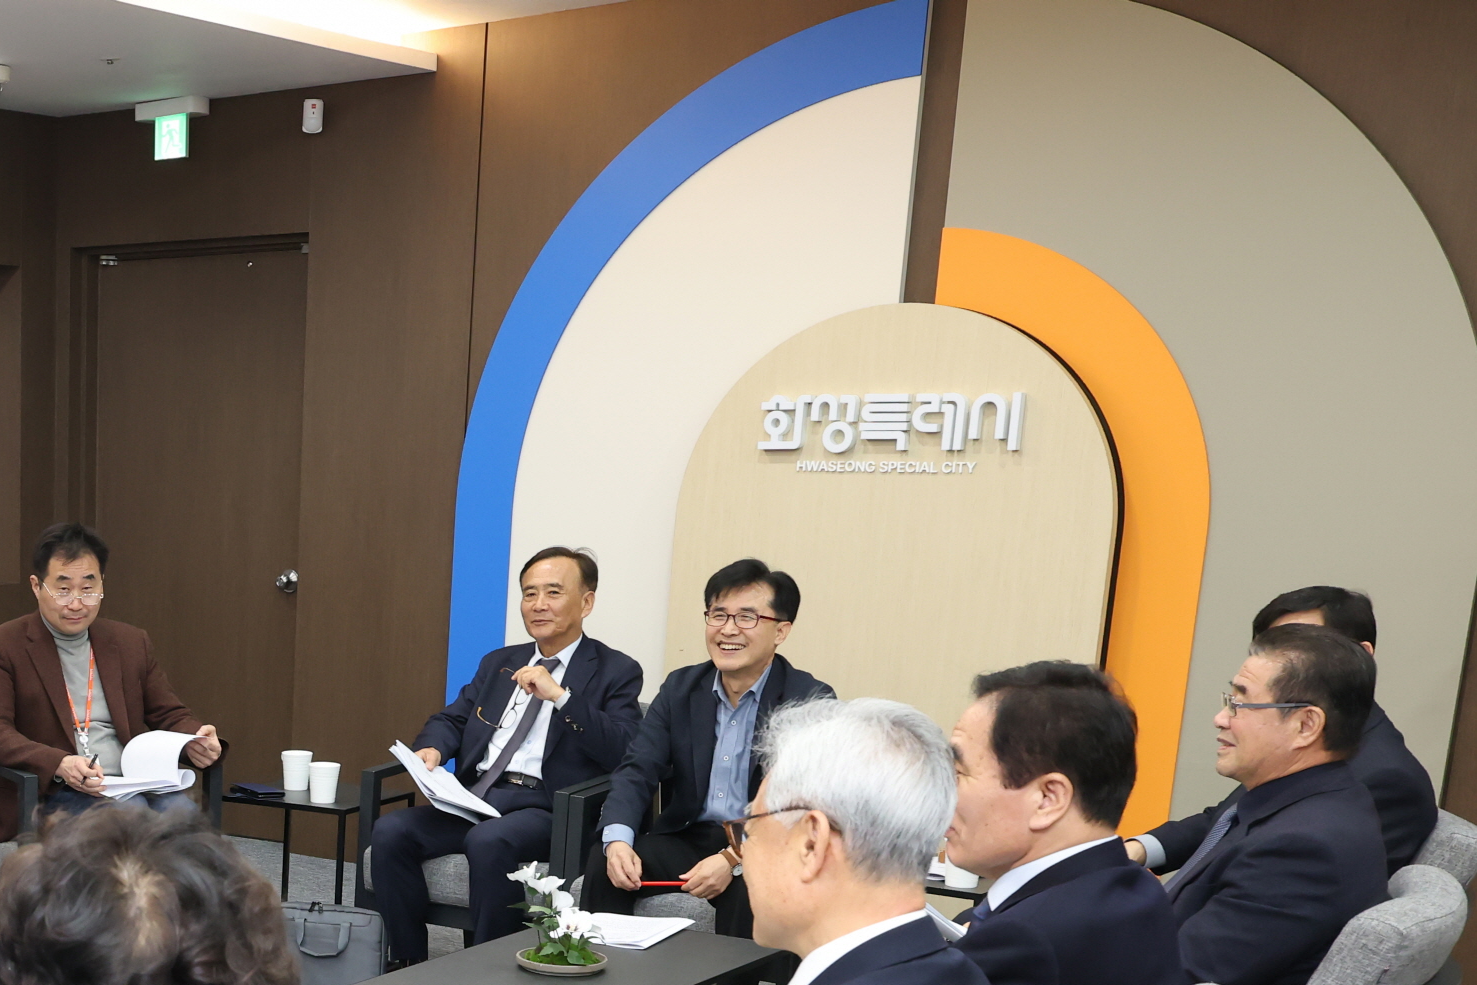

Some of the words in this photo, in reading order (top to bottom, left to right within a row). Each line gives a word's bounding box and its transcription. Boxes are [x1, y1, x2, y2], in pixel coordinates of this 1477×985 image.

[757, 392, 1027, 454] 화성특례시
[795, 460, 875, 473] HWASEONG
[879, 460, 938, 474] SPECIAL
[941, 461, 977, 474] CITY
